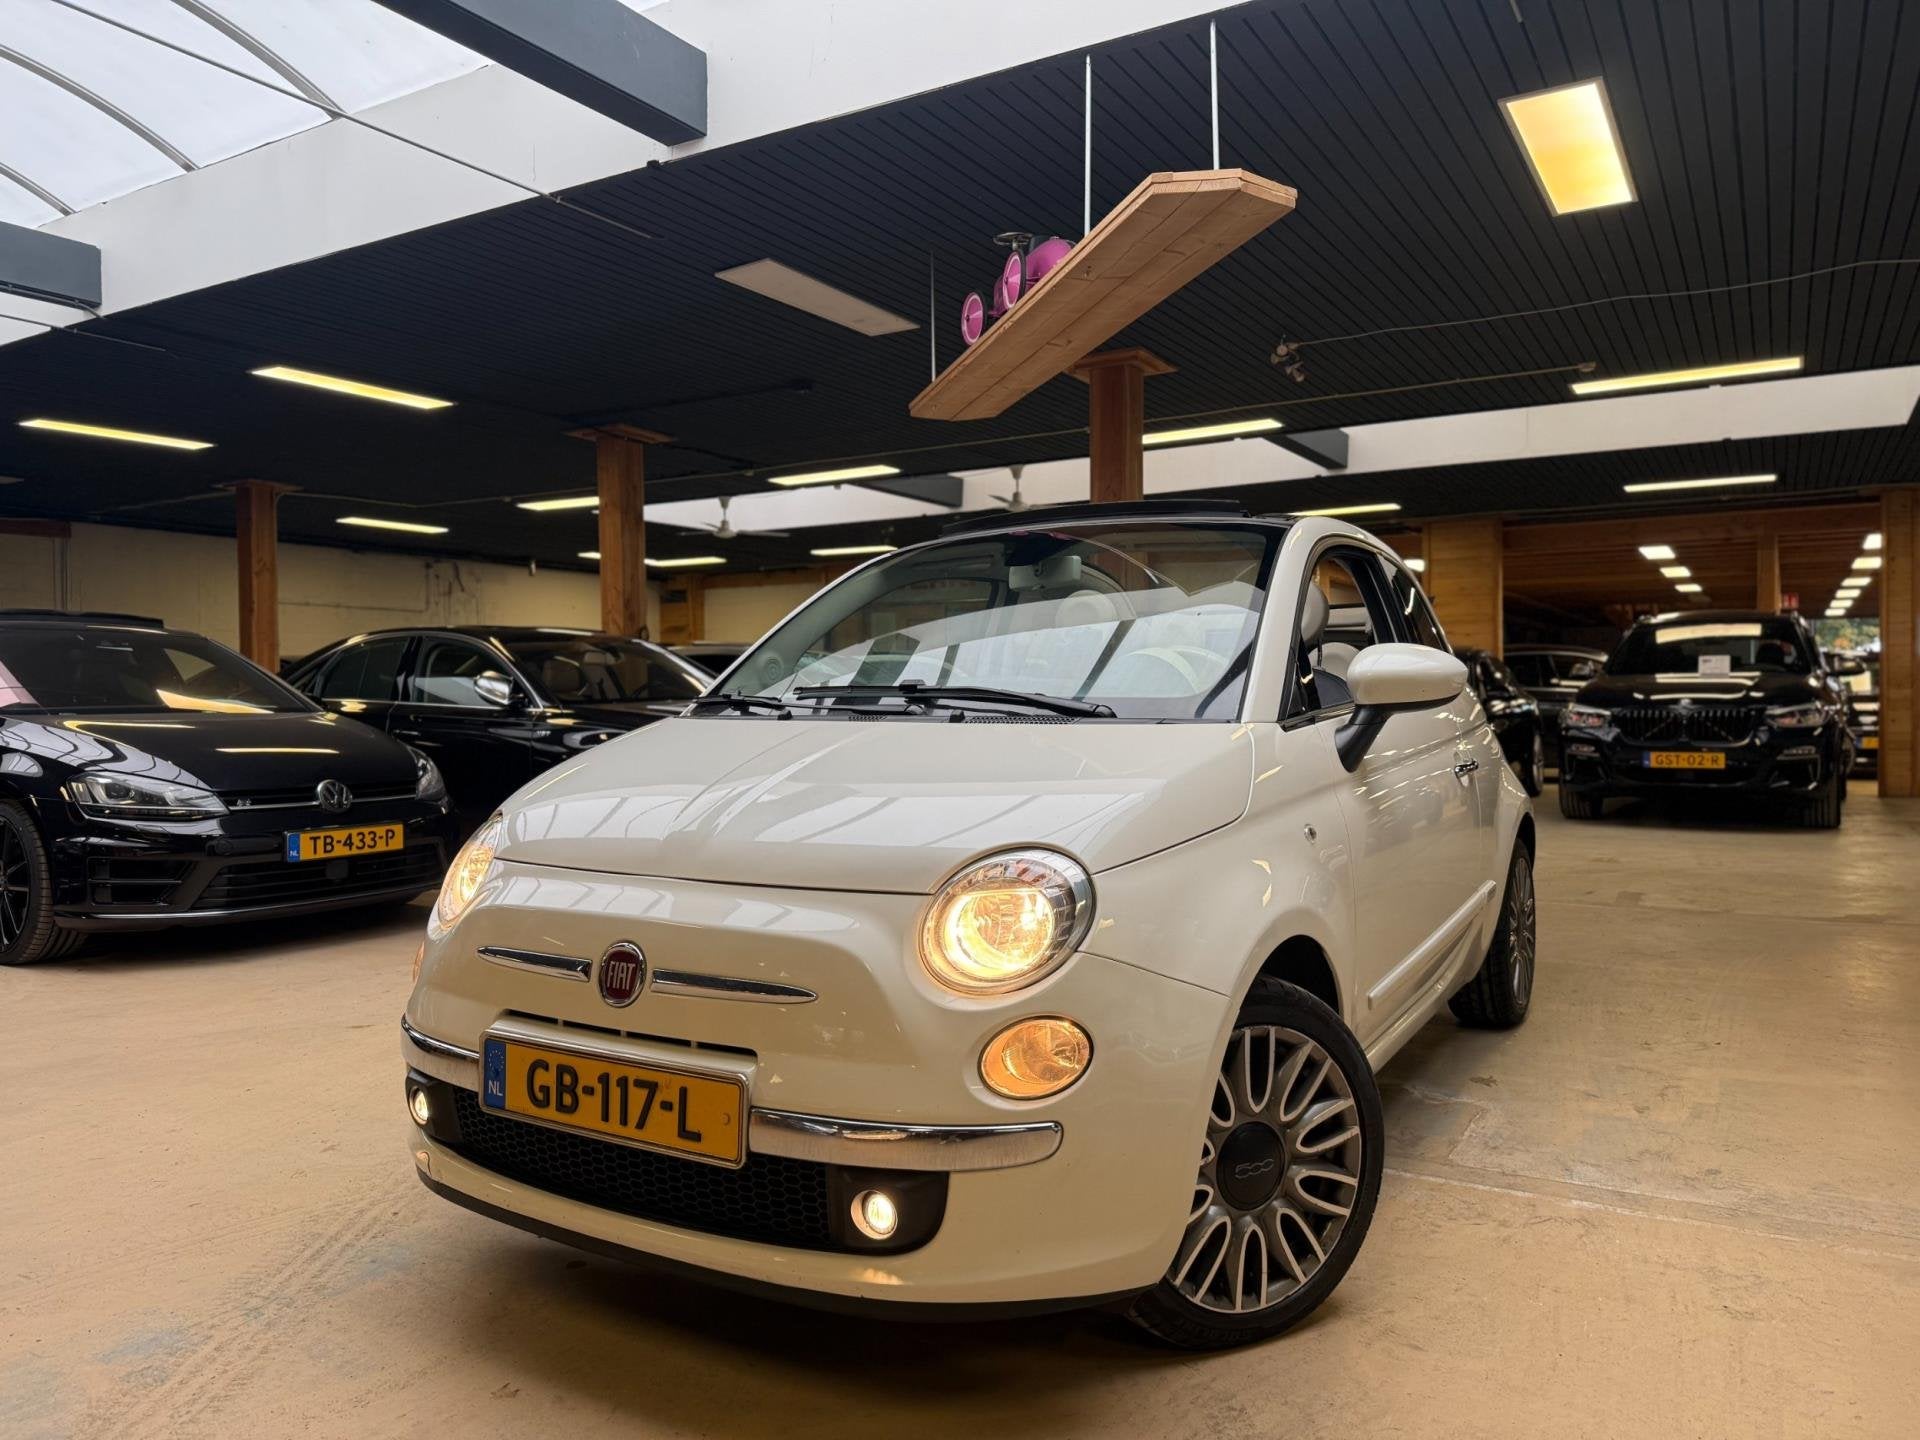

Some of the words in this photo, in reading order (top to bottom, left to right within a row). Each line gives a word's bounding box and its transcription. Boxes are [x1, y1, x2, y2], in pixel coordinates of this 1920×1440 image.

[309, 829, 395, 855] TB-433-P
[607, 961, 636, 990] FIAT
[488, 1080, 503, 1096] NL
[527, 1058, 702, 1143] GB-117-L
